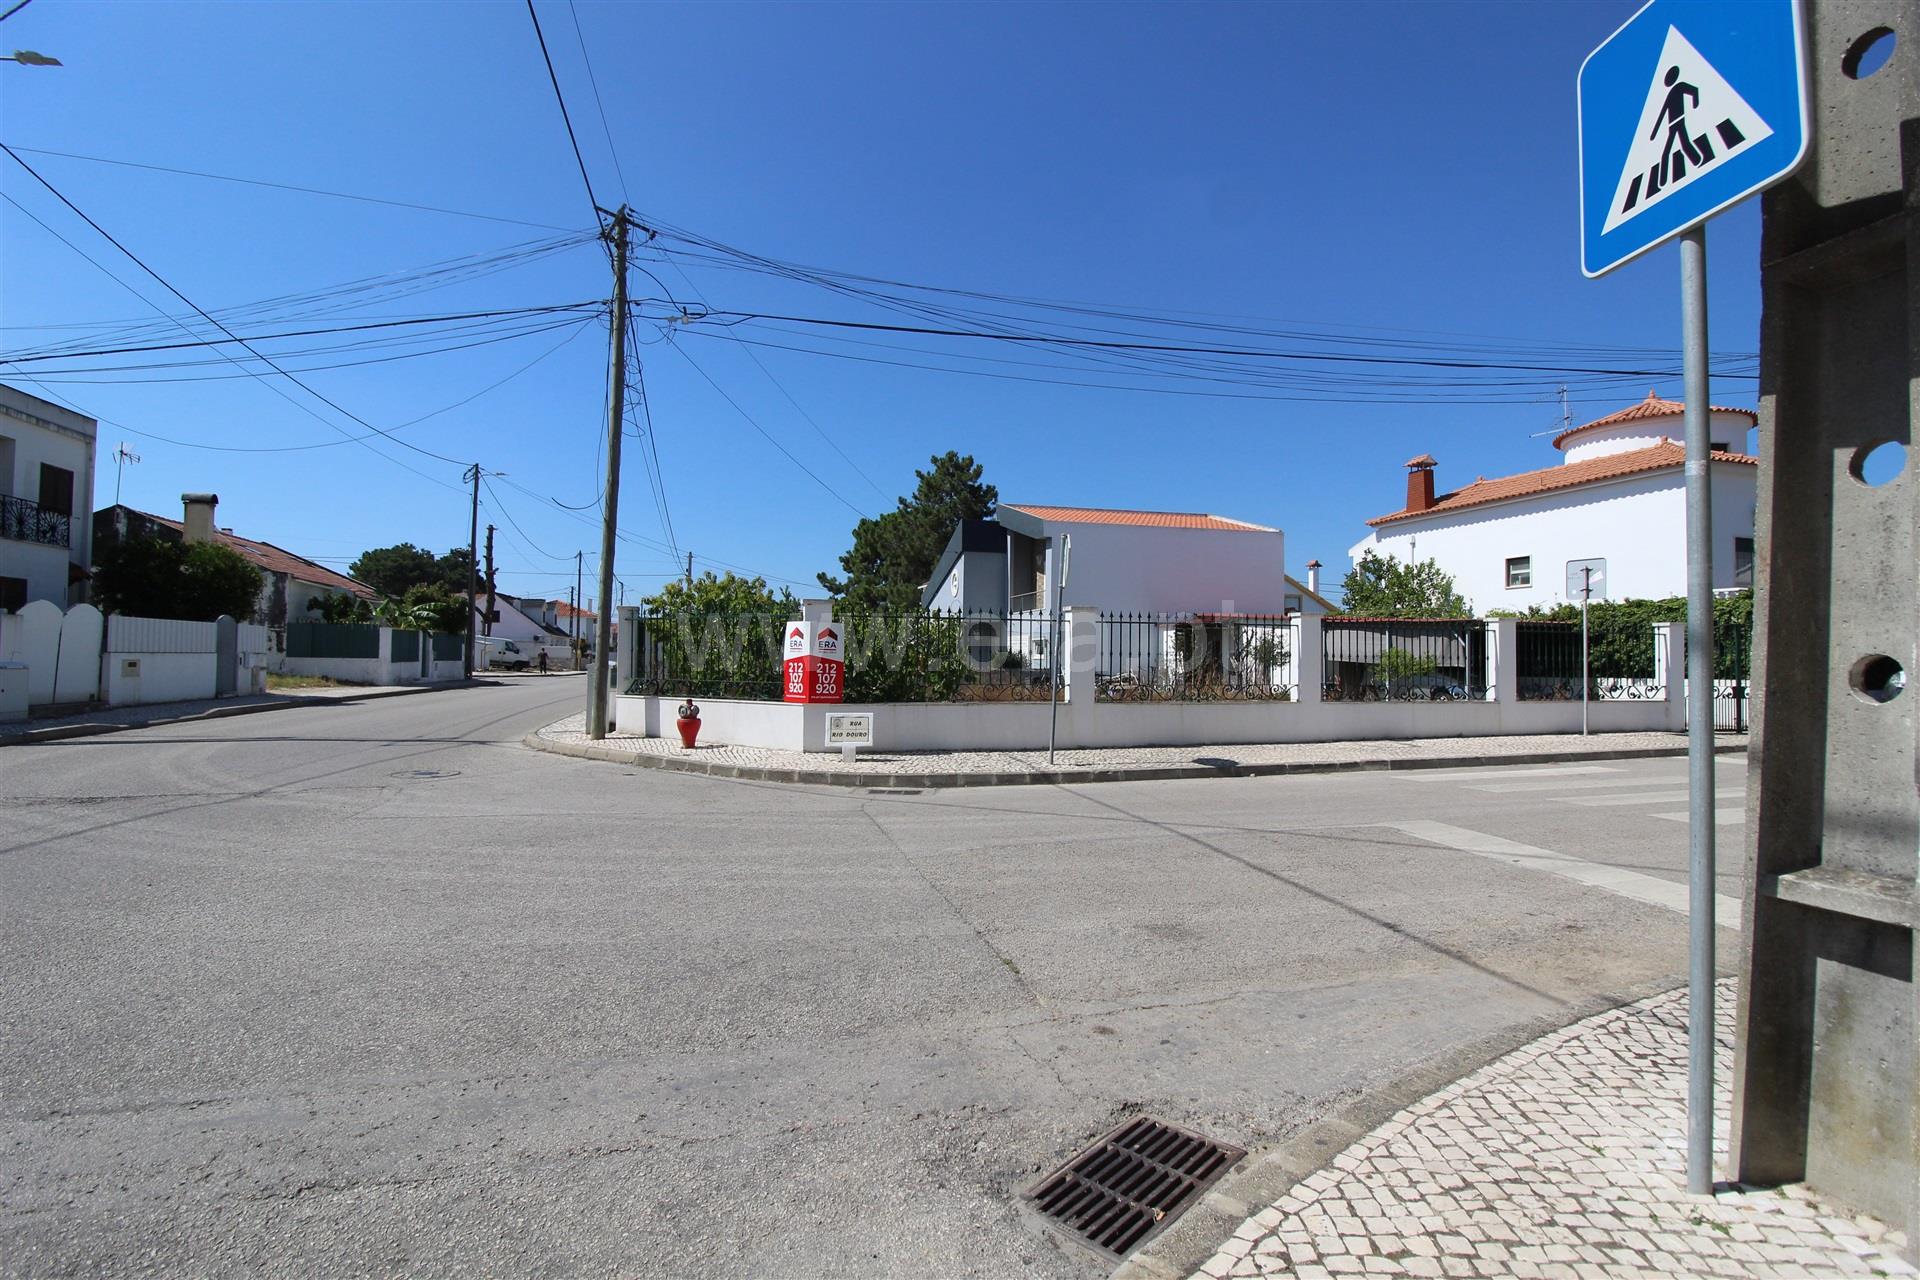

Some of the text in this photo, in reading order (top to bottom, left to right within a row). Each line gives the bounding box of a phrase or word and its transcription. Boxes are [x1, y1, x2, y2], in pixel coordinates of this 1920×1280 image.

[790, 640, 803, 648] ERA
[818, 640, 837, 649] ERA
[789, 663, 803, 673] 212
[816, 663, 837, 673] 212
[790, 673, 803, 683] 107
[817, 673, 836, 684] 107
[789, 683, 804, 693] 920
[816, 684, 836, 694] 920
